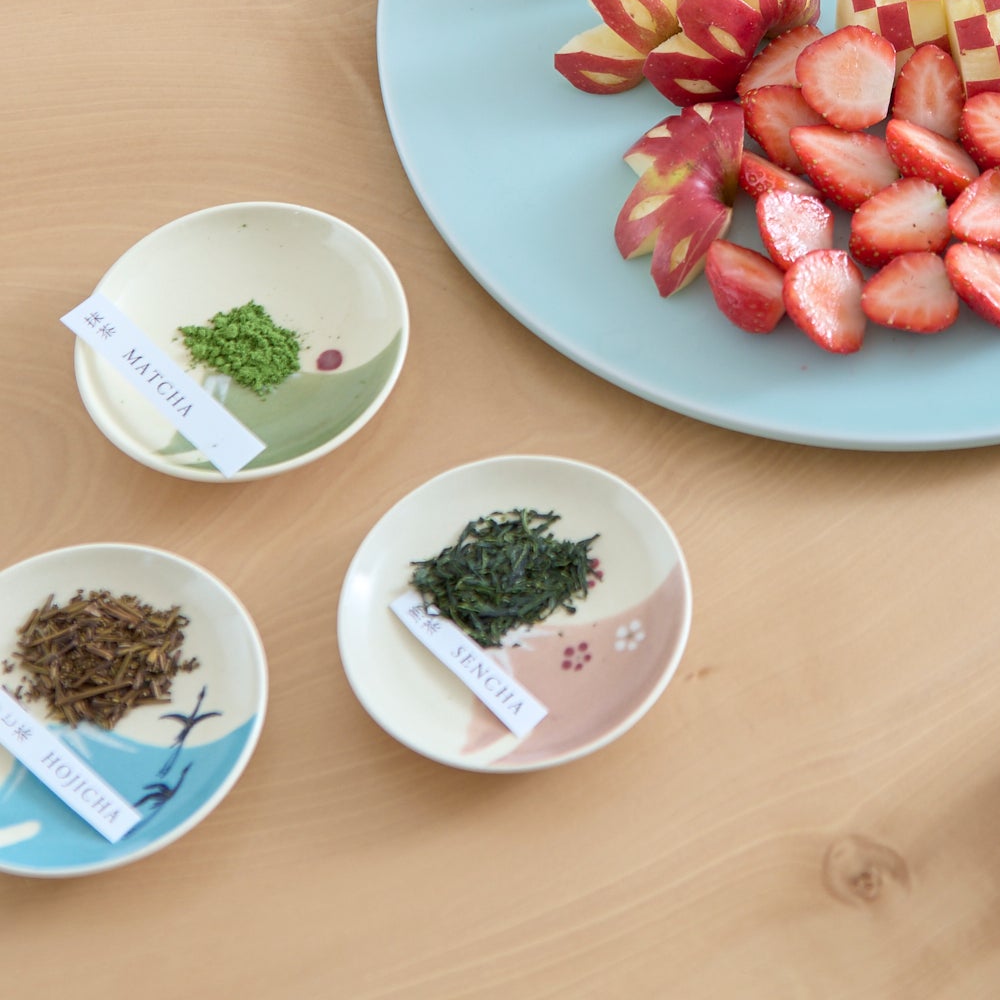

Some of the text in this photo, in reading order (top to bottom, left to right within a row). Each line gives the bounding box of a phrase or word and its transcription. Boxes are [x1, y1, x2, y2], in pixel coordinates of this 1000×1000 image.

[122, 348, 194, 418] MATCHA
[450, 646, 524, 716] SENCHA
[40, 751, 121, 825] HOJICHA
